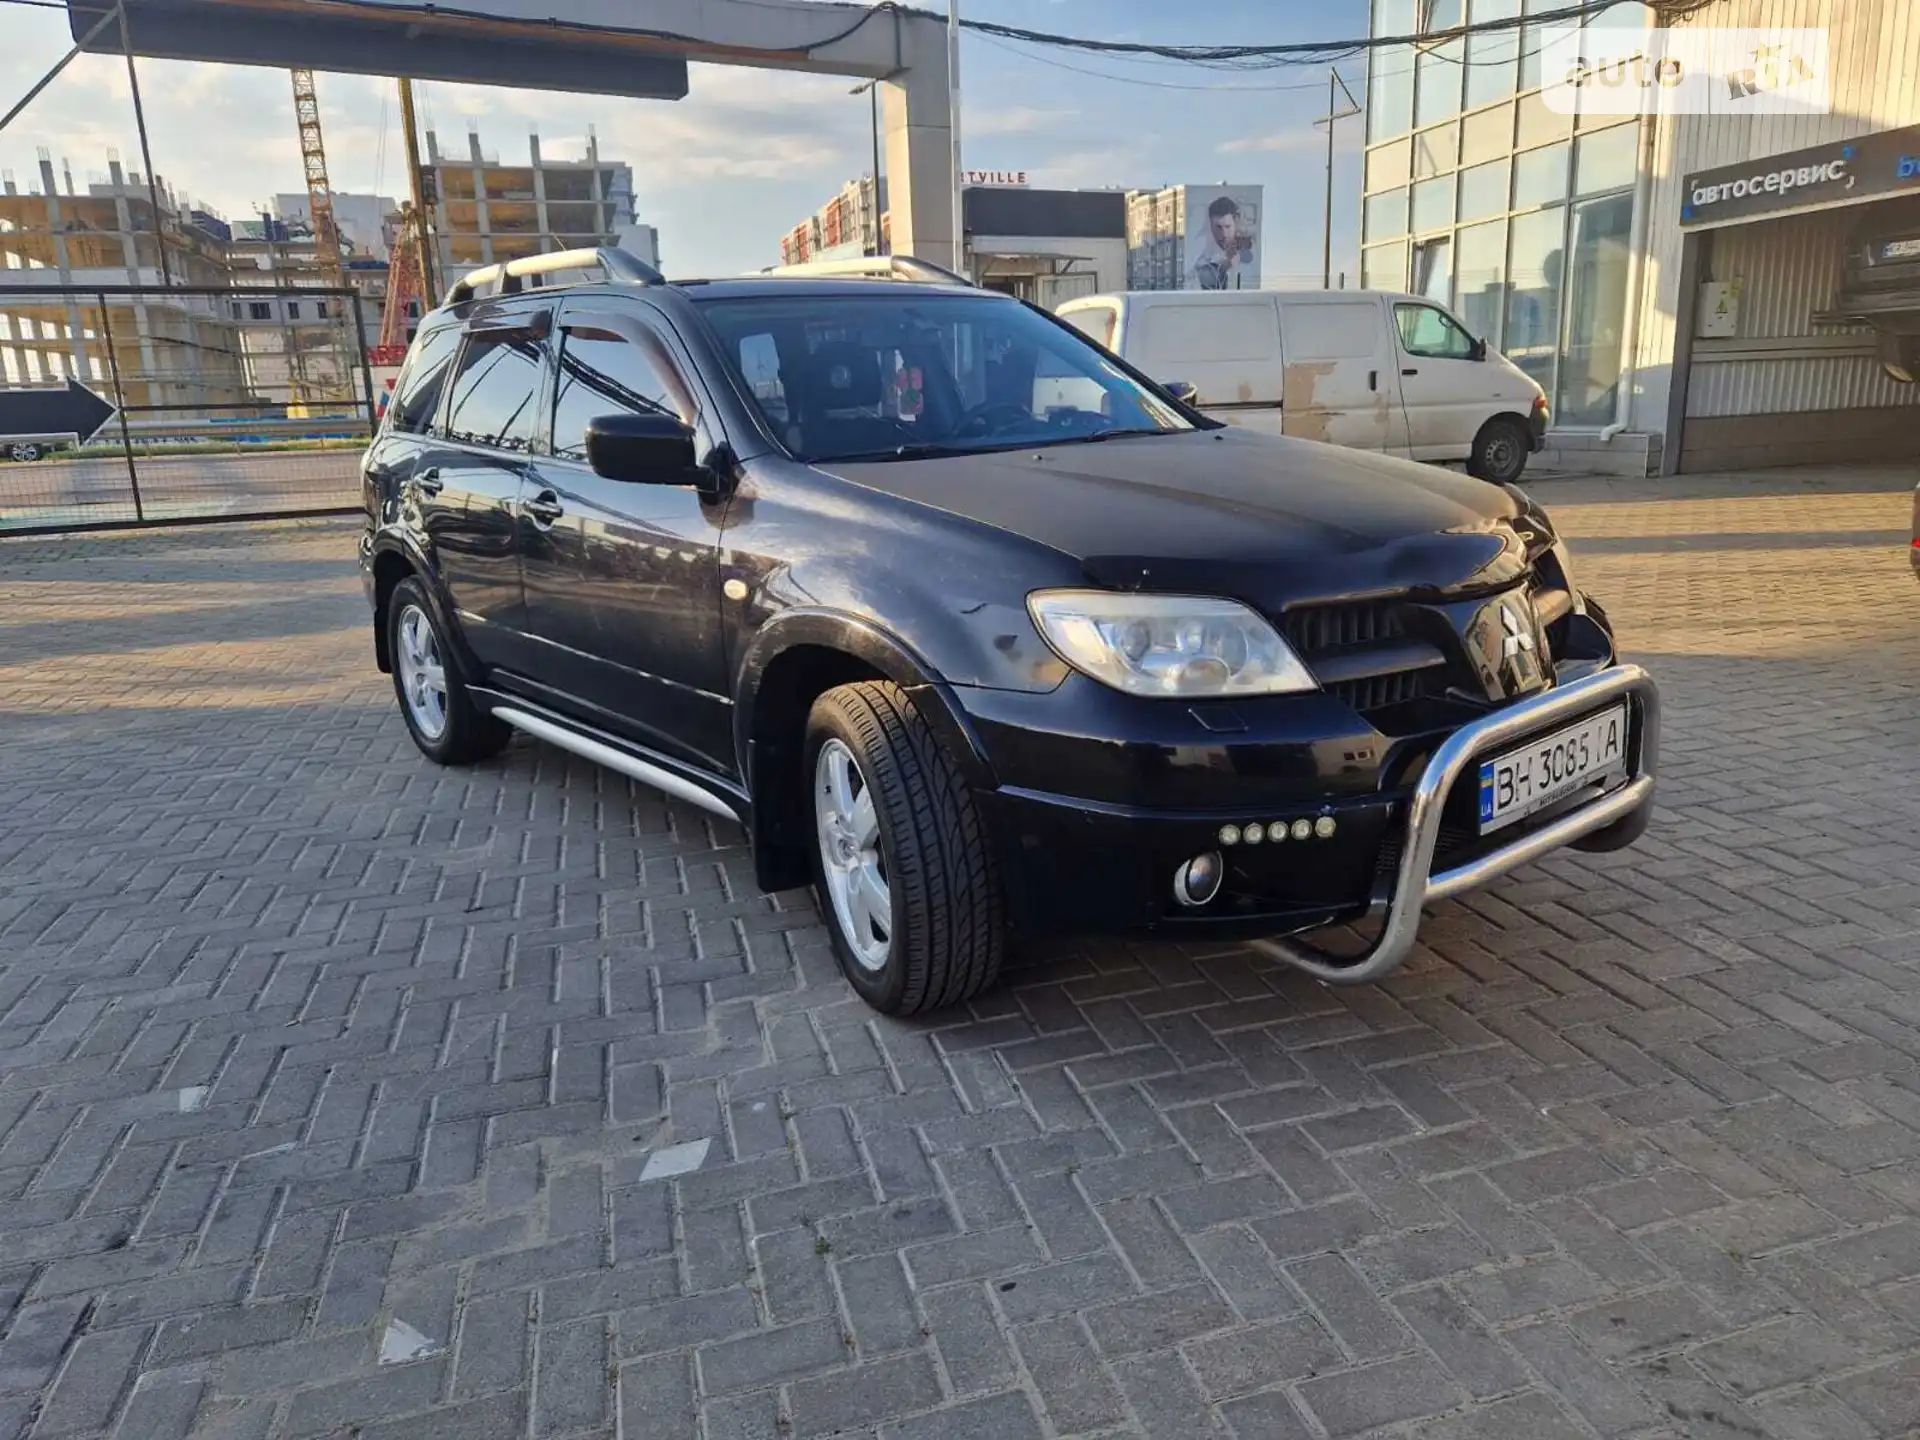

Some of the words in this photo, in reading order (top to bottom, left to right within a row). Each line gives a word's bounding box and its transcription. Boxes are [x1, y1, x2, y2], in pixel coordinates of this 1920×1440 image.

[1691, 159, 1848, 206] автосервис
[1498, 757, 1533, 810] BH
[1539, 733, 1589, 789] 3085
